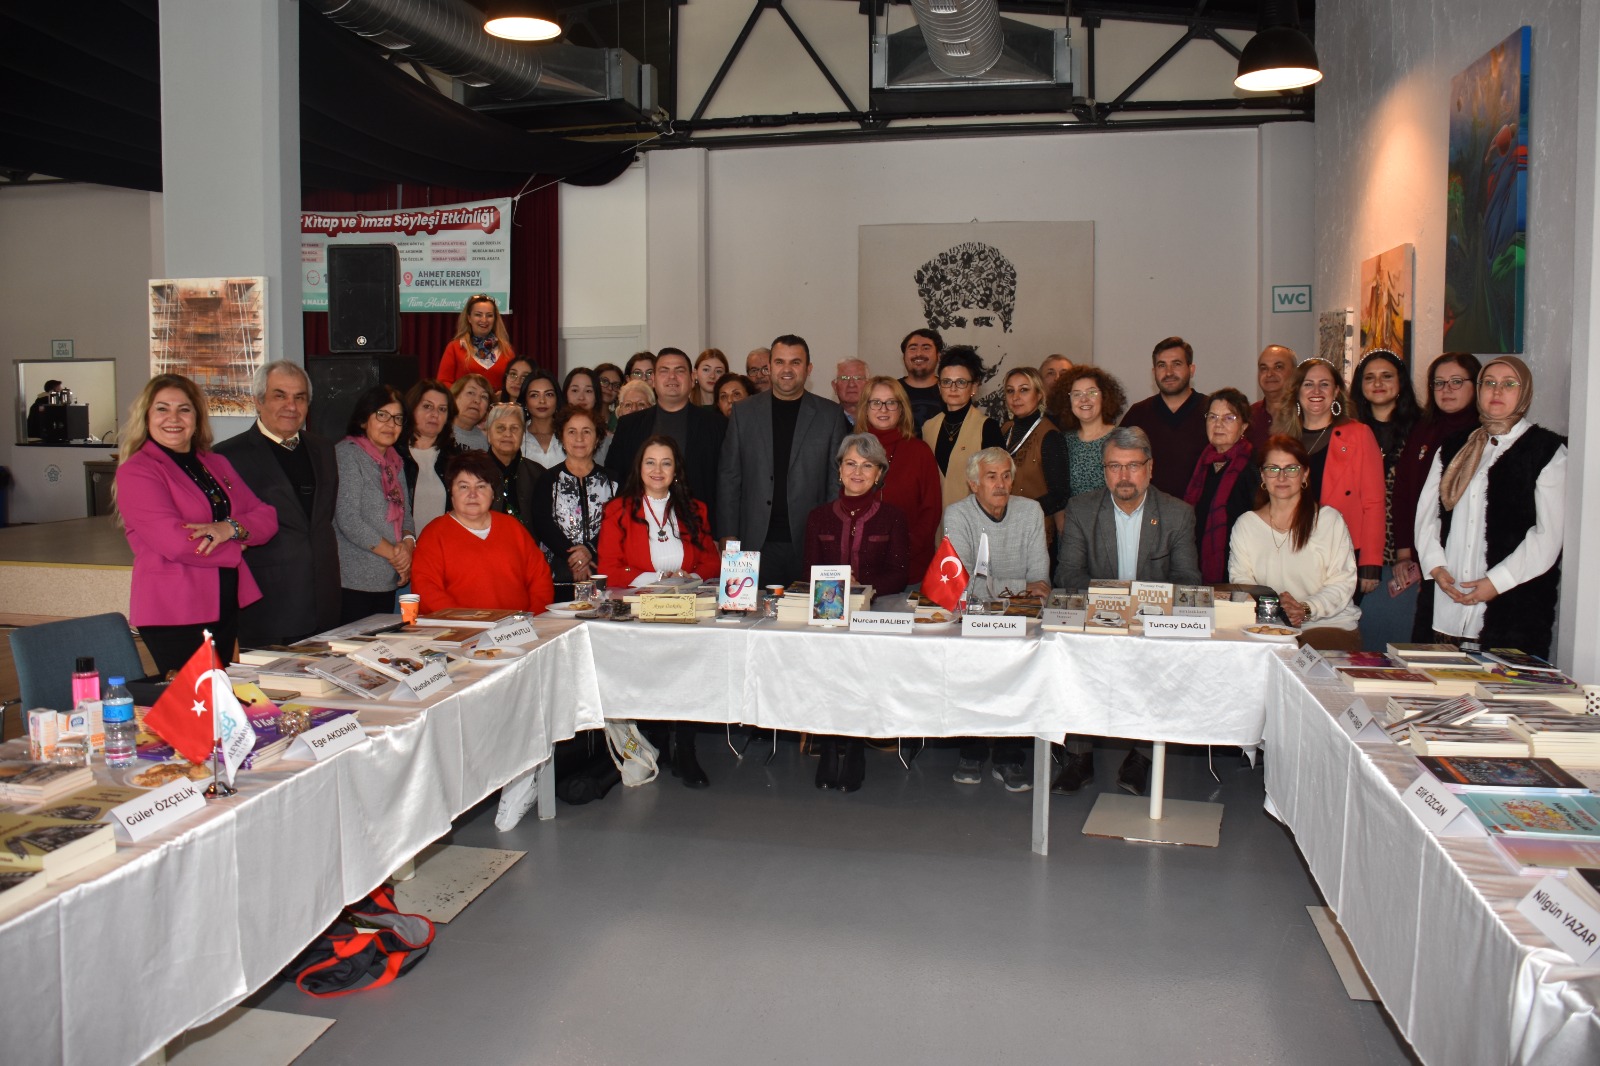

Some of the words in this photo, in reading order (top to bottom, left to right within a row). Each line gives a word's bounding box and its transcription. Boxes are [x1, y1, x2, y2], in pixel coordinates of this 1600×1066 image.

[304, 215, 339, 231] Kitap
[341, 218, 357, 228] ve
[394, 211, 440, 230] Söyleşi
[440, 207, 495, 228] Etkinliği
[418, 270, 445, 278] AHMET
[446, 270, 481, 278] ERENSOY
[414, 277, 448, 288] GENÇLİK
[448, 278, 482, 287] MERKEZİ
[1278, 293, 1306, 305] WC
[1137, 589, 1169, 604] DÜN
[1095, 599, 1127, 611] DÜN
[511, 627, 531, 637] MUTLU
[993, 622, 1017, 630] ÇALIK
[1149, 621, 1179, 630] Tuncay
[1180, 621, 1206, 629] DAĞLI
[413, 678, 431, 692] Mustafa
[312, 738, 327, 748] Ege
[326, 722, 358, 741] AKDEMİR
[126, 808, 155, 826] Güler
[154, 786, 197, 812] ÖZÇELİK
[1415, 786, 1429, 798] Elif
[1424, 793, 1448, 817] ÖZCAN
[1533, 889, 1563, 919] Nilgün
[1562, 912, 1597, 947] YAZAR
